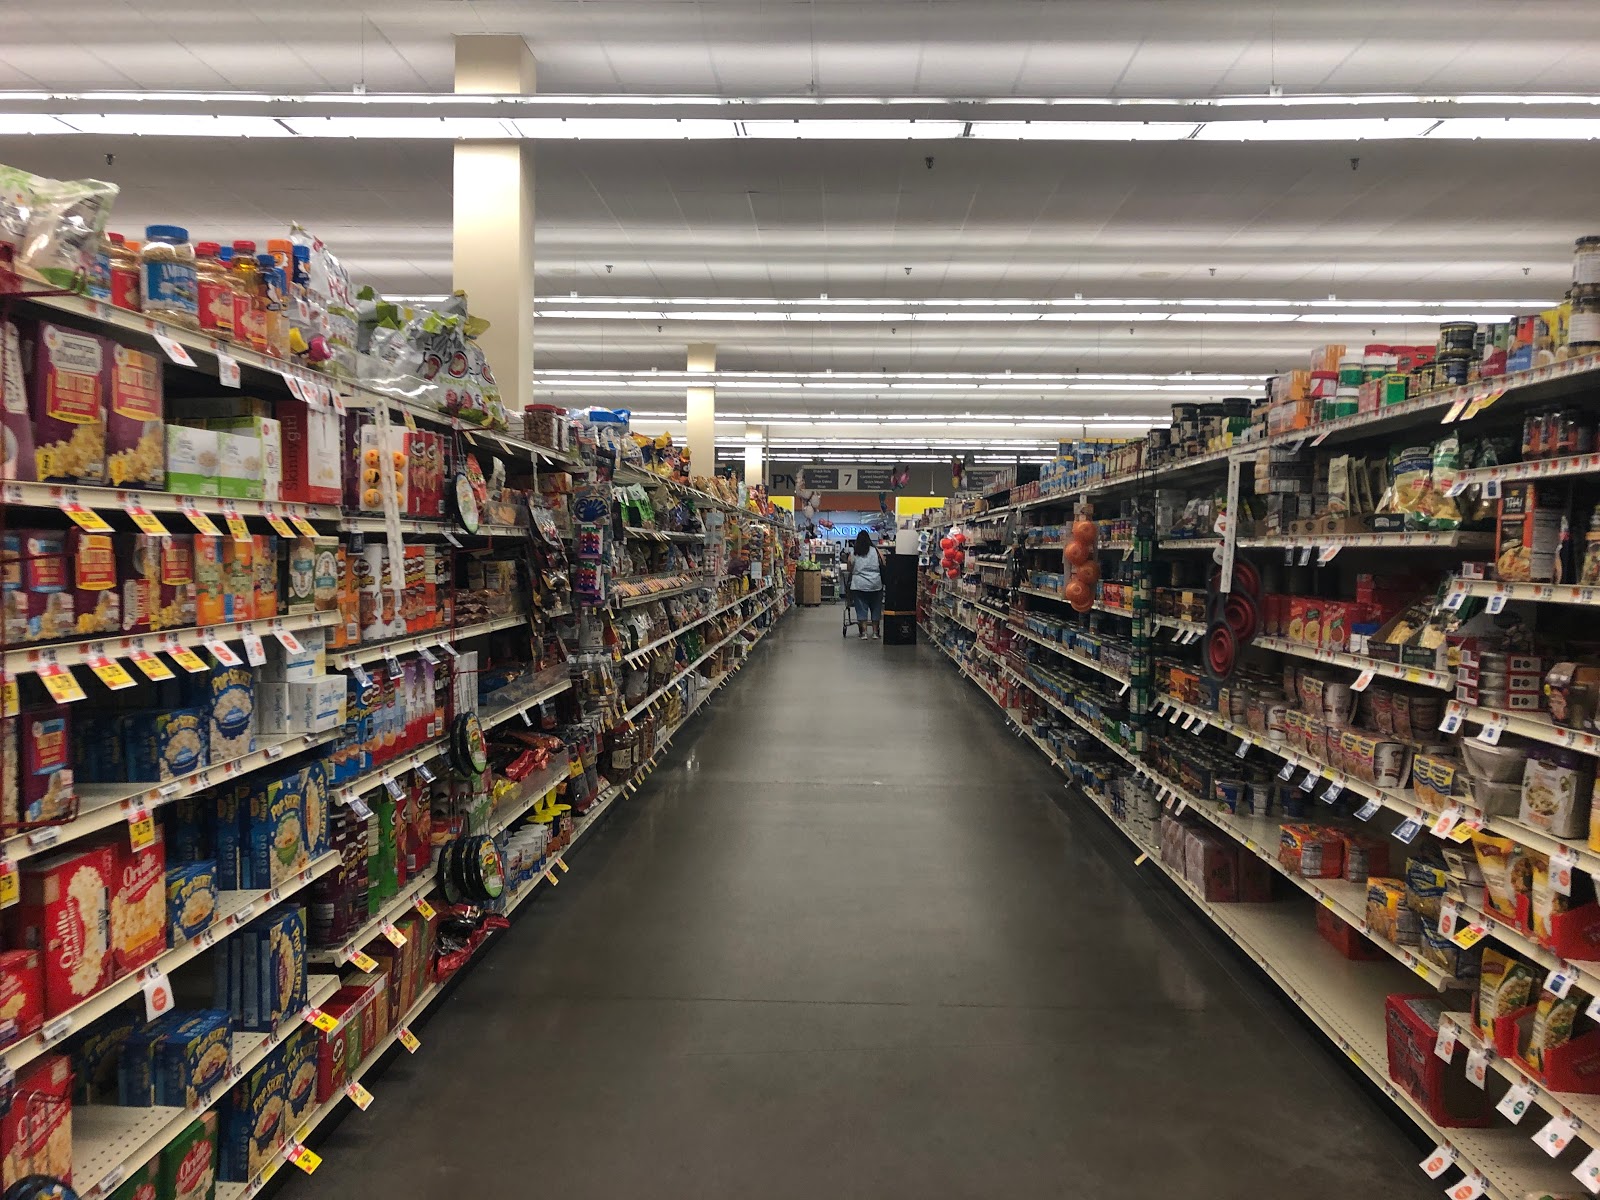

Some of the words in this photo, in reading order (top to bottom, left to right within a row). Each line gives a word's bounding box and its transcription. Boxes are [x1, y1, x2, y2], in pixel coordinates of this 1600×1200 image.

[284, 415, 300, 492] Skinnygirl
[843, 474, 852, 486] 7
[122, 852, 156, 887] Orville
[57, 909, 74, 970] Orville
